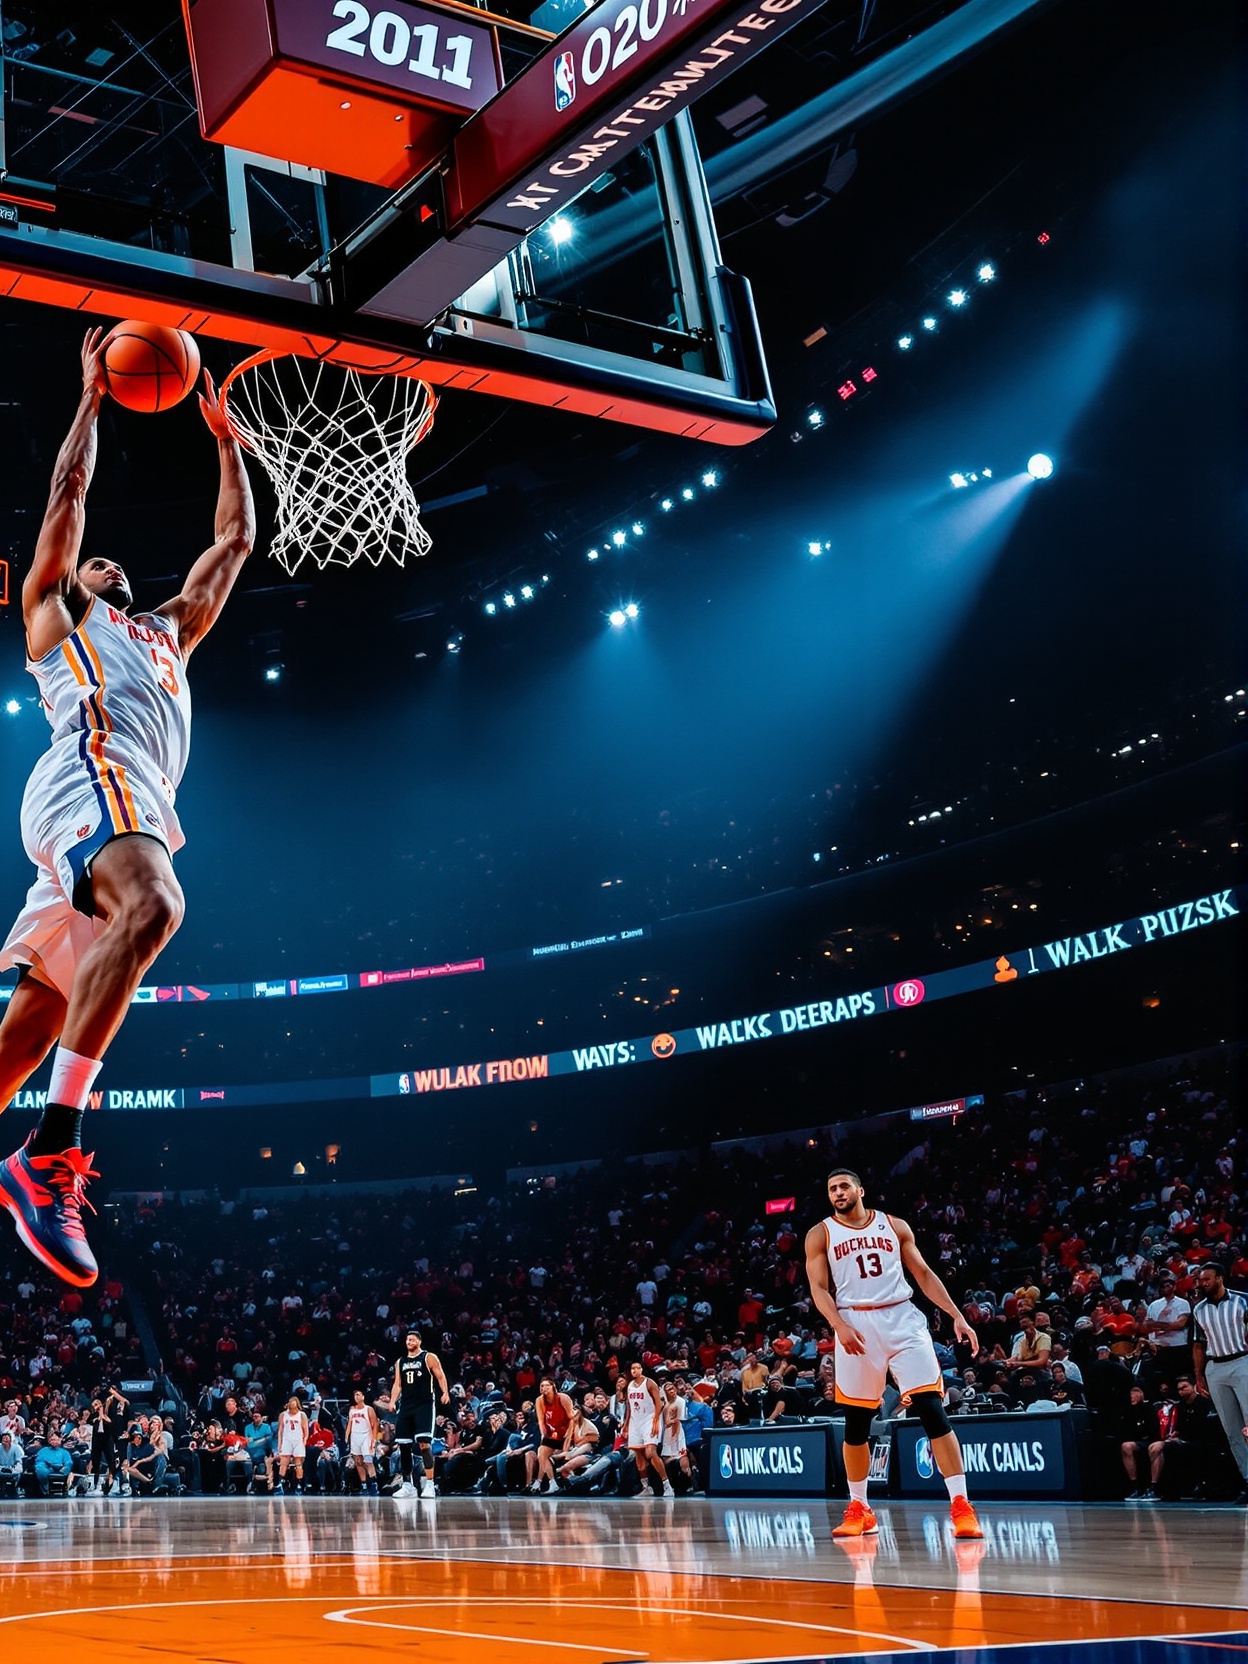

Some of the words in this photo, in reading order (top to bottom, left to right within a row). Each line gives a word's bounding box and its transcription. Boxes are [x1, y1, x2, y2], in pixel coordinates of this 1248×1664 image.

[325, 0, 473, 90] 2011
[1044, 923, 1132, 968] WALK
[855, 1252, 883, 1279] 13
[769, 1446, 804, 1474] CALS
